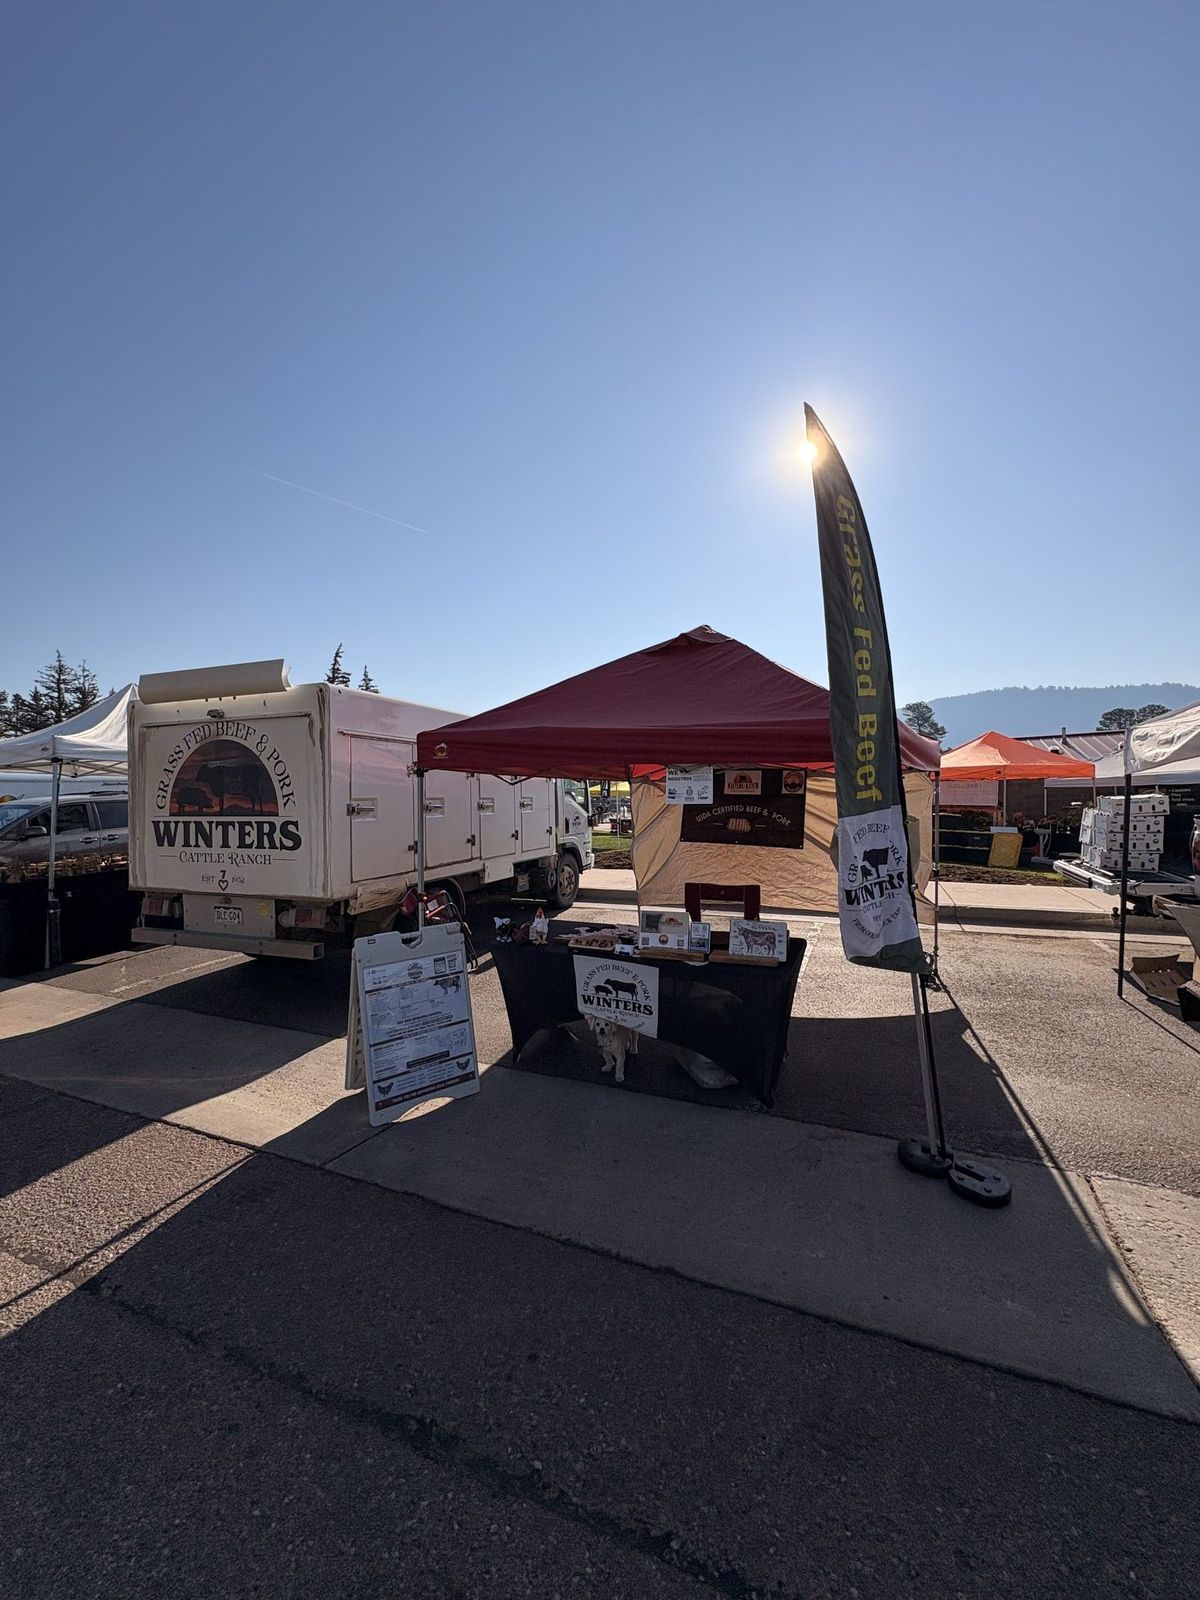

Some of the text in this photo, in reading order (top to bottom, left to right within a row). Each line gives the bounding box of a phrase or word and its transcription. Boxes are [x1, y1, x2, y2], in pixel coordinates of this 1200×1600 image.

[836, 494, 883, 802] Grass Fed Beef
[156, 720, 296, 810] GRASS FED BEEF & PORK
[696, 812, 712, 823] USDA
[712, 805, 744, 815] CERTIFIED
[746, 805, 762, 814] BEEF
[771, 811, 791, 828] PORK
[152, 820, 303, 852] WINTERS
[178, 850, 272, 867] CATTLE RANCH
[220, 870, 226, 879] 7
[583, 968, 596, 992] GRASS
[612, 964, 633, 975] BEEF
[637, 980, 652, 1001] PORK
[581, 994, 654, 1016] WINTERS
